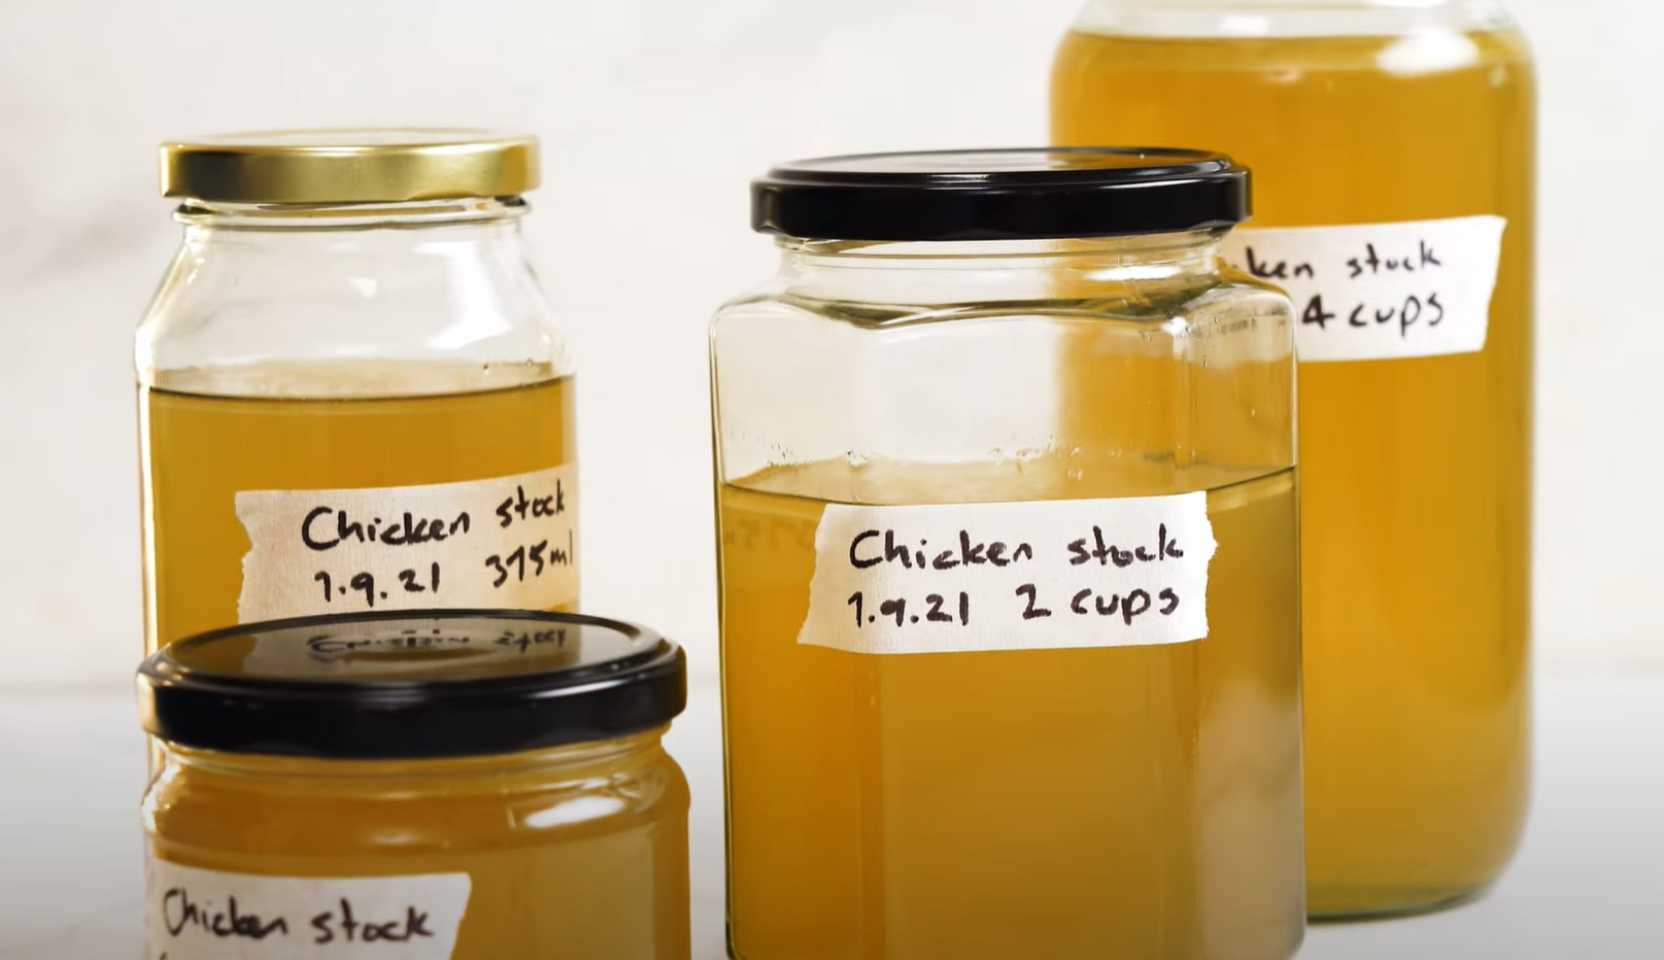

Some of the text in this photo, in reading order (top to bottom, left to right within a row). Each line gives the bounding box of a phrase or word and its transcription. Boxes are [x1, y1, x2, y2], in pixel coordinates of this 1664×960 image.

[1302, 294, 1336, 330] 4
[1348, 292, 1444, 337] cups
[301, 479, 565, 551] Chicken stock
[849, 529, 1032, 570] Chicken
[1068, 523, 1184, 567] stock
[1015, 584, 1052, 620] 2
[1070, 588, 1179, 626] cups
[310, 897, 433, 945] stock
